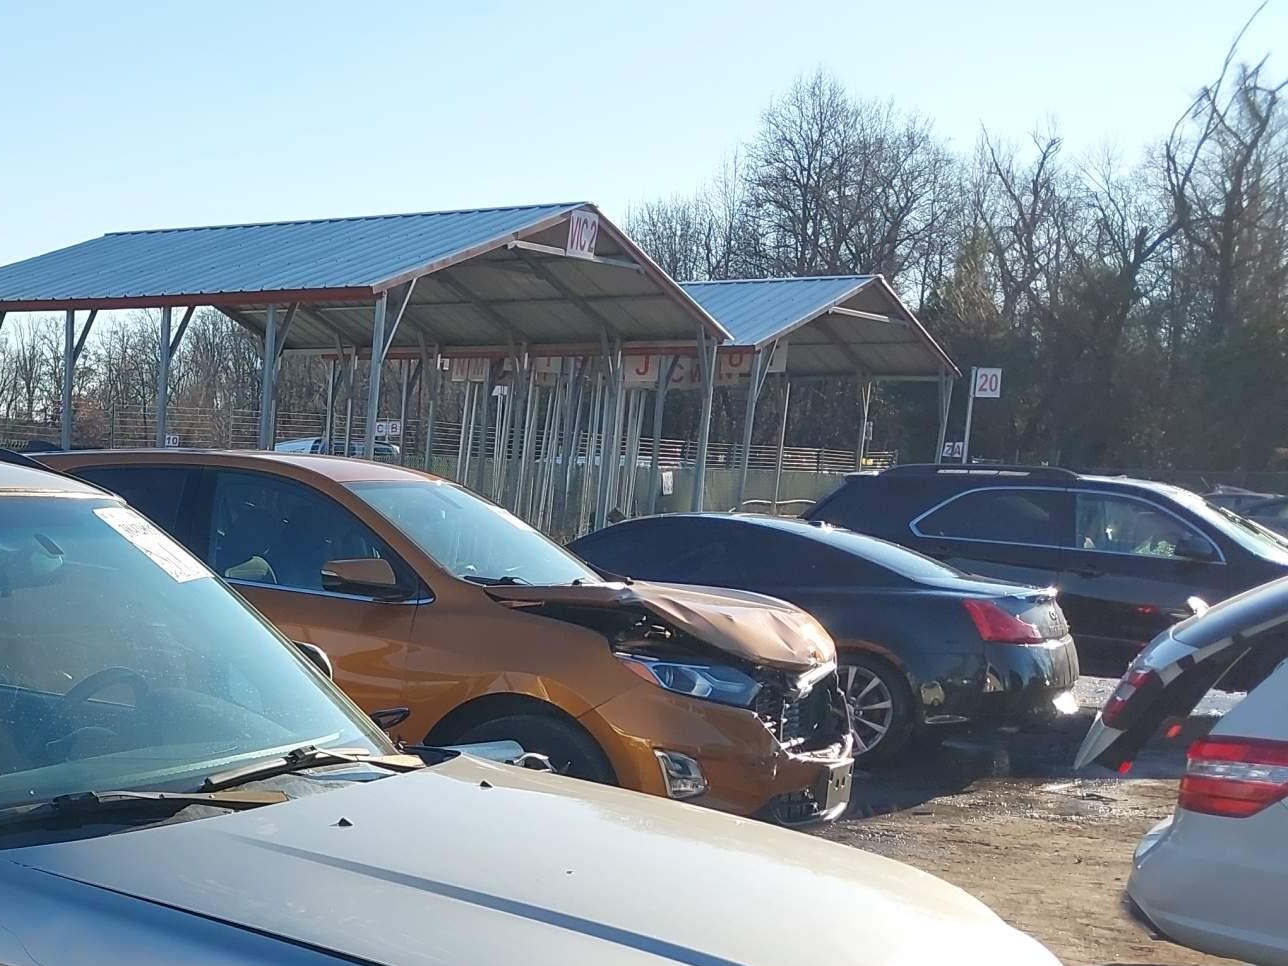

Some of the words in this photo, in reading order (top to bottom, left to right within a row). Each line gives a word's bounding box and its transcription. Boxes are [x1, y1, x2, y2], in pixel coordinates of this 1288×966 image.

[570, 215, 588, 251] VIC
[587, 220, 596, 253] 2
[977, 373, 999, 392] 20
[391, 423, 398, 433] B
[166, 436, 178, 445] 10
